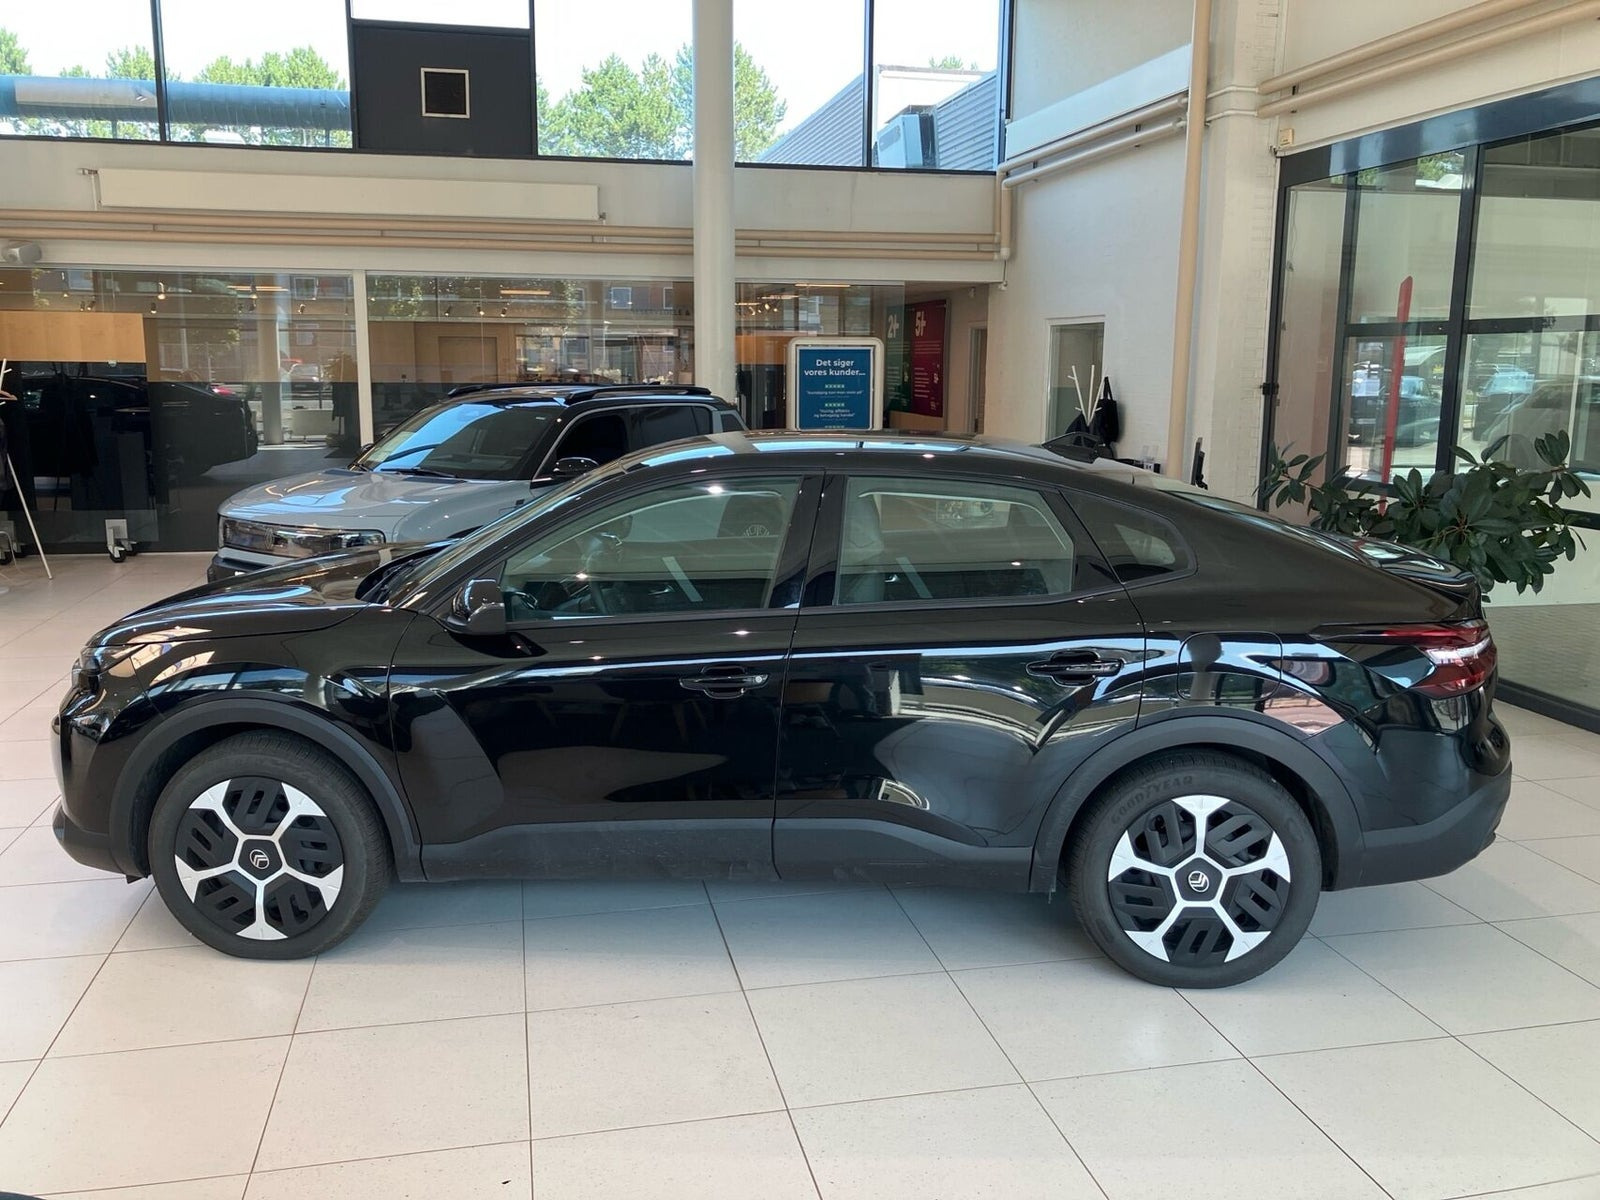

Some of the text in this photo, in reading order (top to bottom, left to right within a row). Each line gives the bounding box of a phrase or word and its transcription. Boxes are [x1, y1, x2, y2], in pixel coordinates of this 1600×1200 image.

[815, 358, 855, 368] Det siger
[1111, 775, 1193, 824] GOODYEAR
